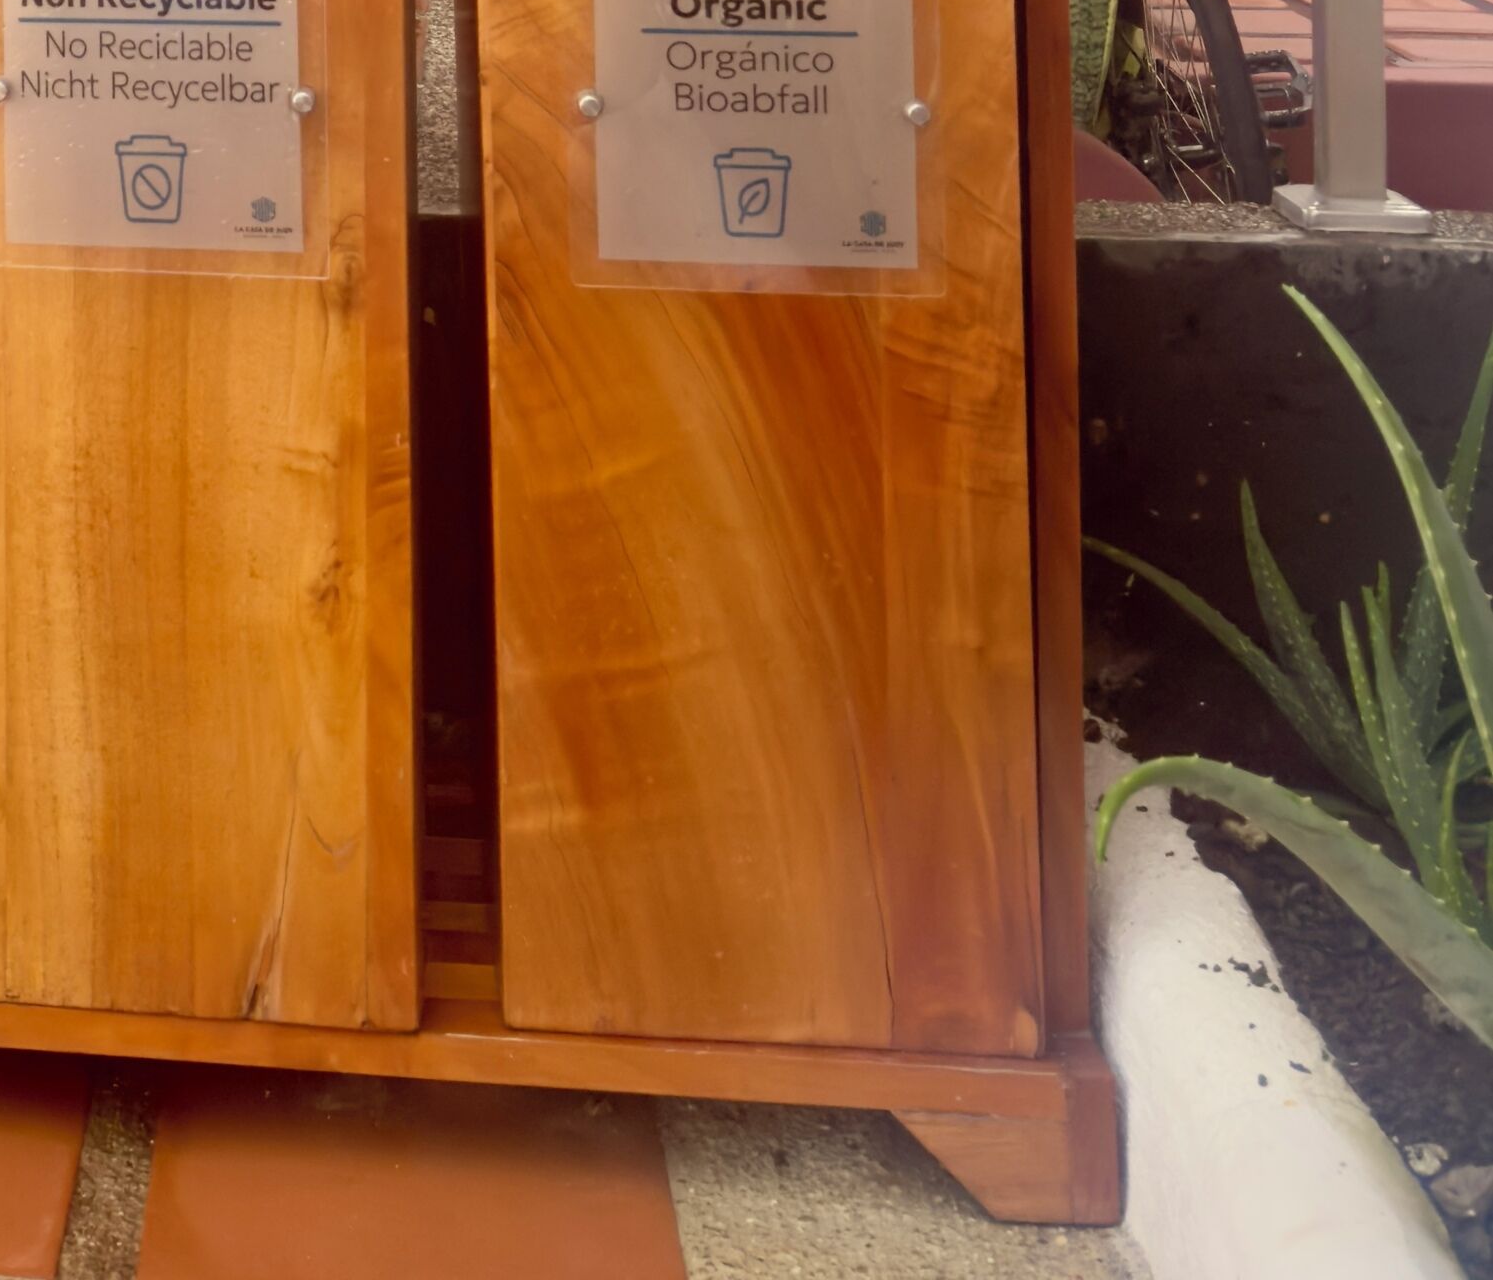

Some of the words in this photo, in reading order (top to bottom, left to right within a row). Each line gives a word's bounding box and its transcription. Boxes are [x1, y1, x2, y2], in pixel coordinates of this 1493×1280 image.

[45, 30, 88, 59] No
[99, 31, 254, 62] Reciclable
[666, 40, 834, 79] Orgánico
[20, 70, 100, 100] Nicht
[111, 71, 281, 109] Recycelbar
[674, 83, 829, 115] Bioabfall
